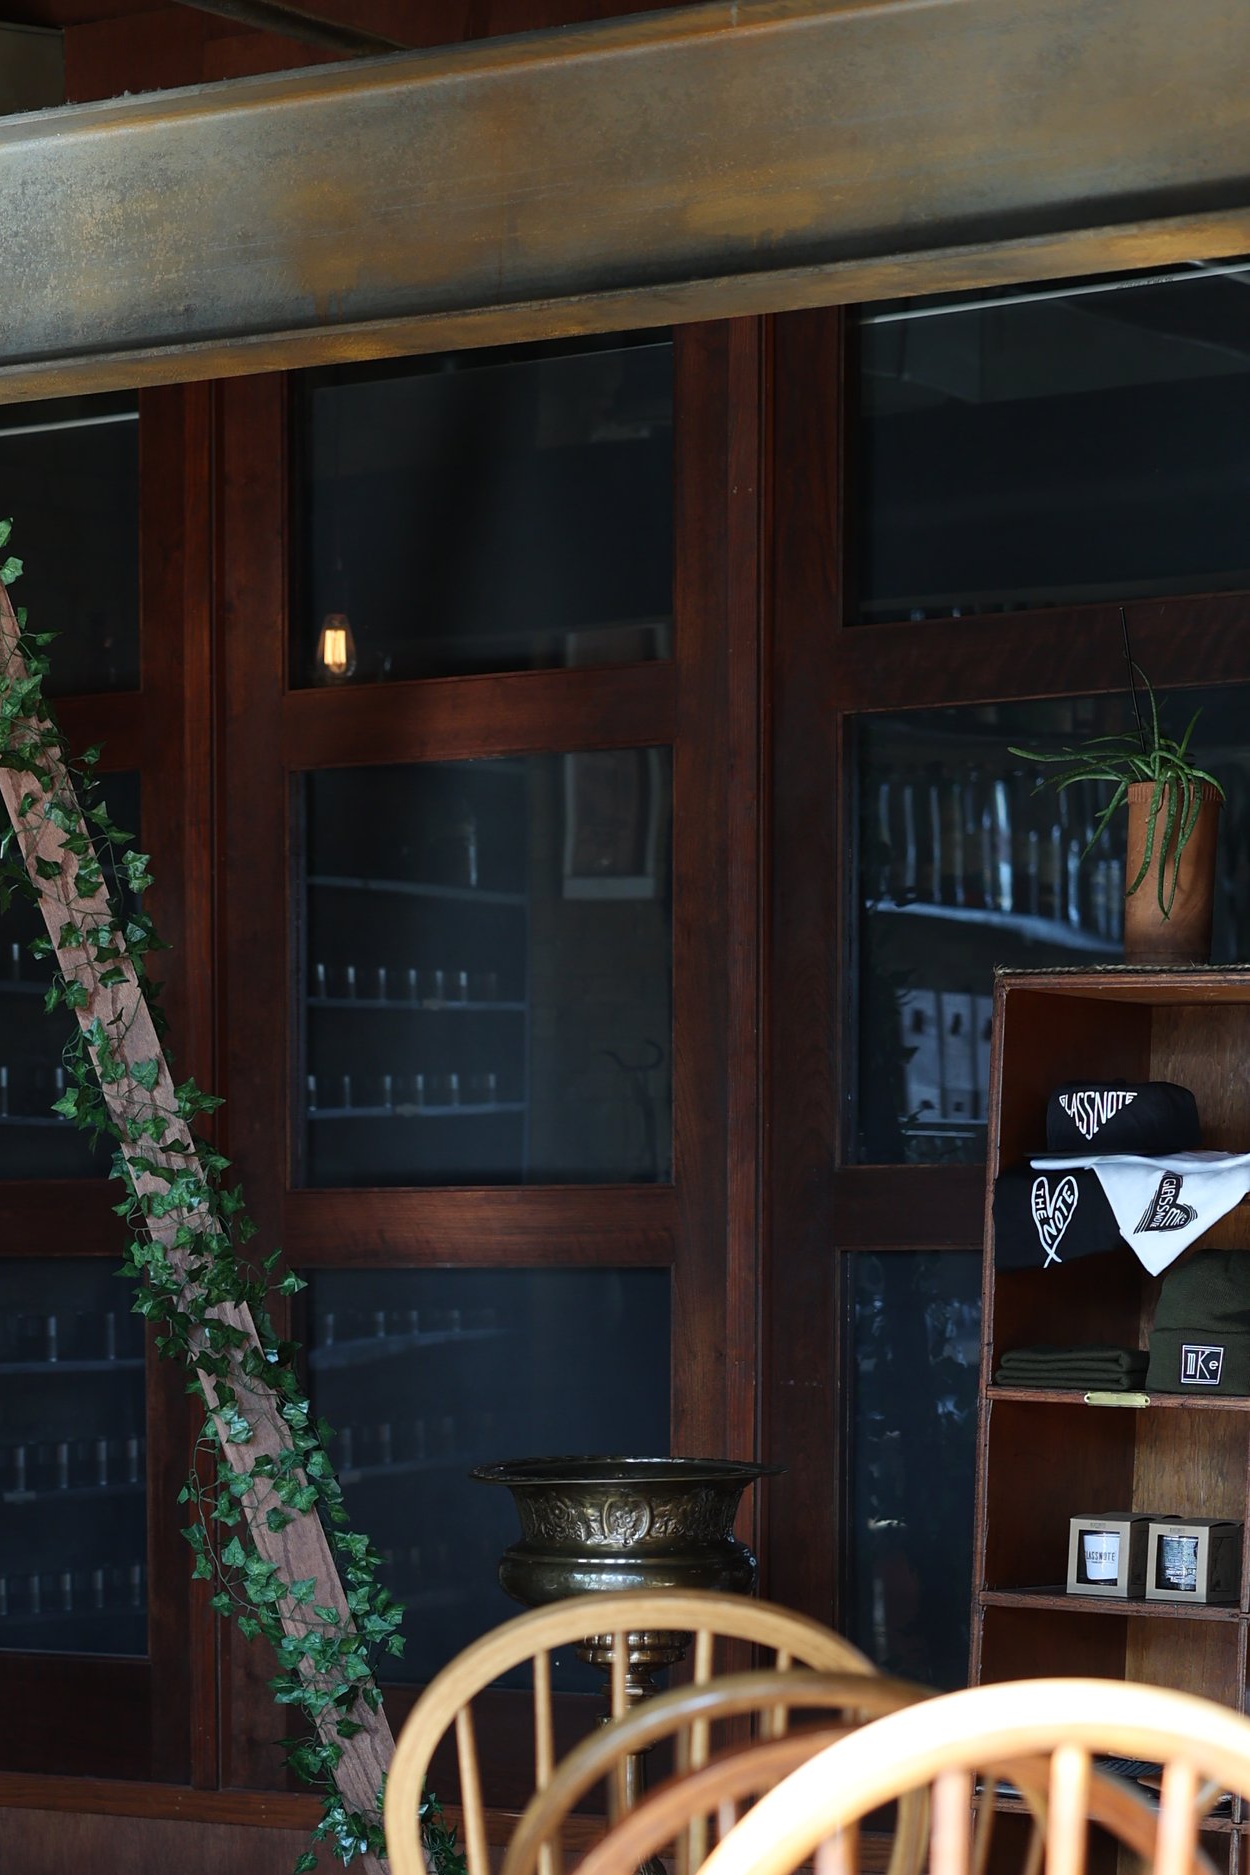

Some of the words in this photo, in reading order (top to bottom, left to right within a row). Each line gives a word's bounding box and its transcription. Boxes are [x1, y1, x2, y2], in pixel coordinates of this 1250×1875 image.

[1058, 1091, 1138, 1140] GLASSNOTE
[1035, 1187, 1048, 1221] THE
[1043, 1184, 1074, 1244] NOTE
